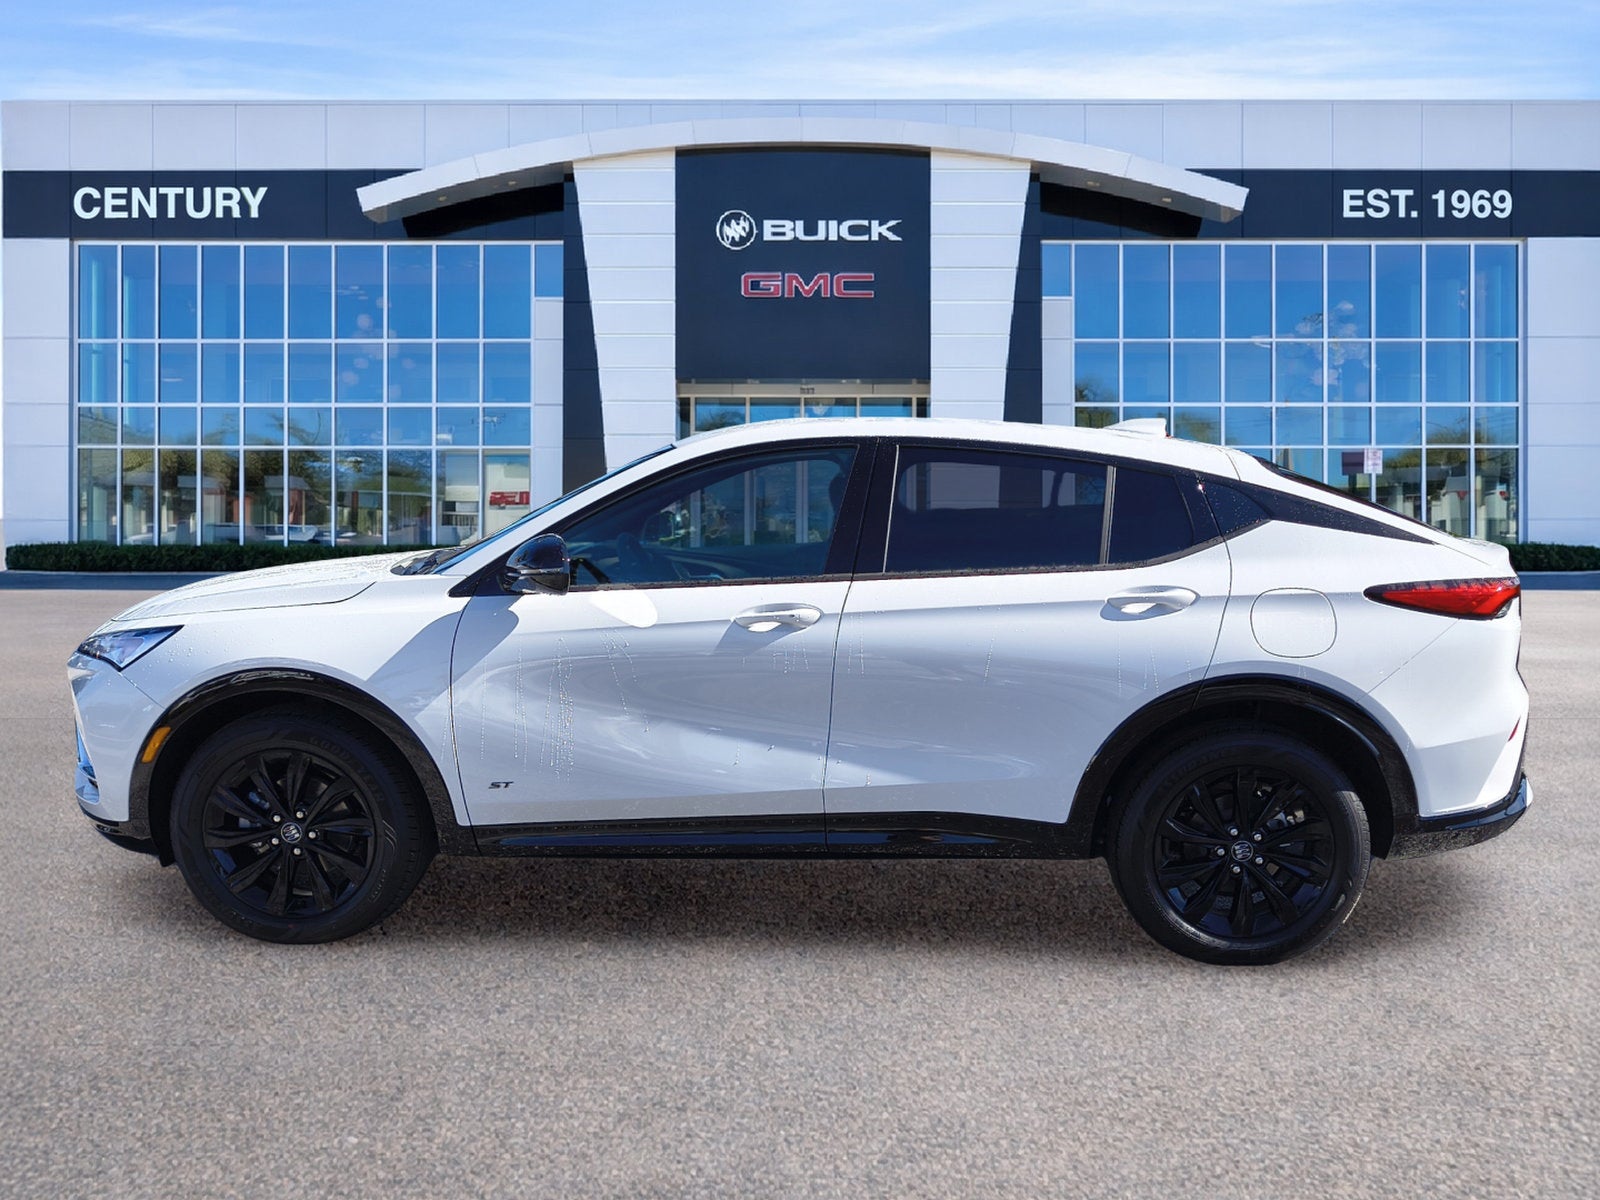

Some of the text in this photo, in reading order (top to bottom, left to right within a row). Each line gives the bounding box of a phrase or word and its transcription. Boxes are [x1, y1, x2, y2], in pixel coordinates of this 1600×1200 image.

[73, 186, 268, 220] CENTURY
[1343, 189, 1513, 219] EST. 1969
[763, 219, 903, 241] BUICK
[741, 272, 875, 298] GMC
[488, 781, 514, 790] ST
